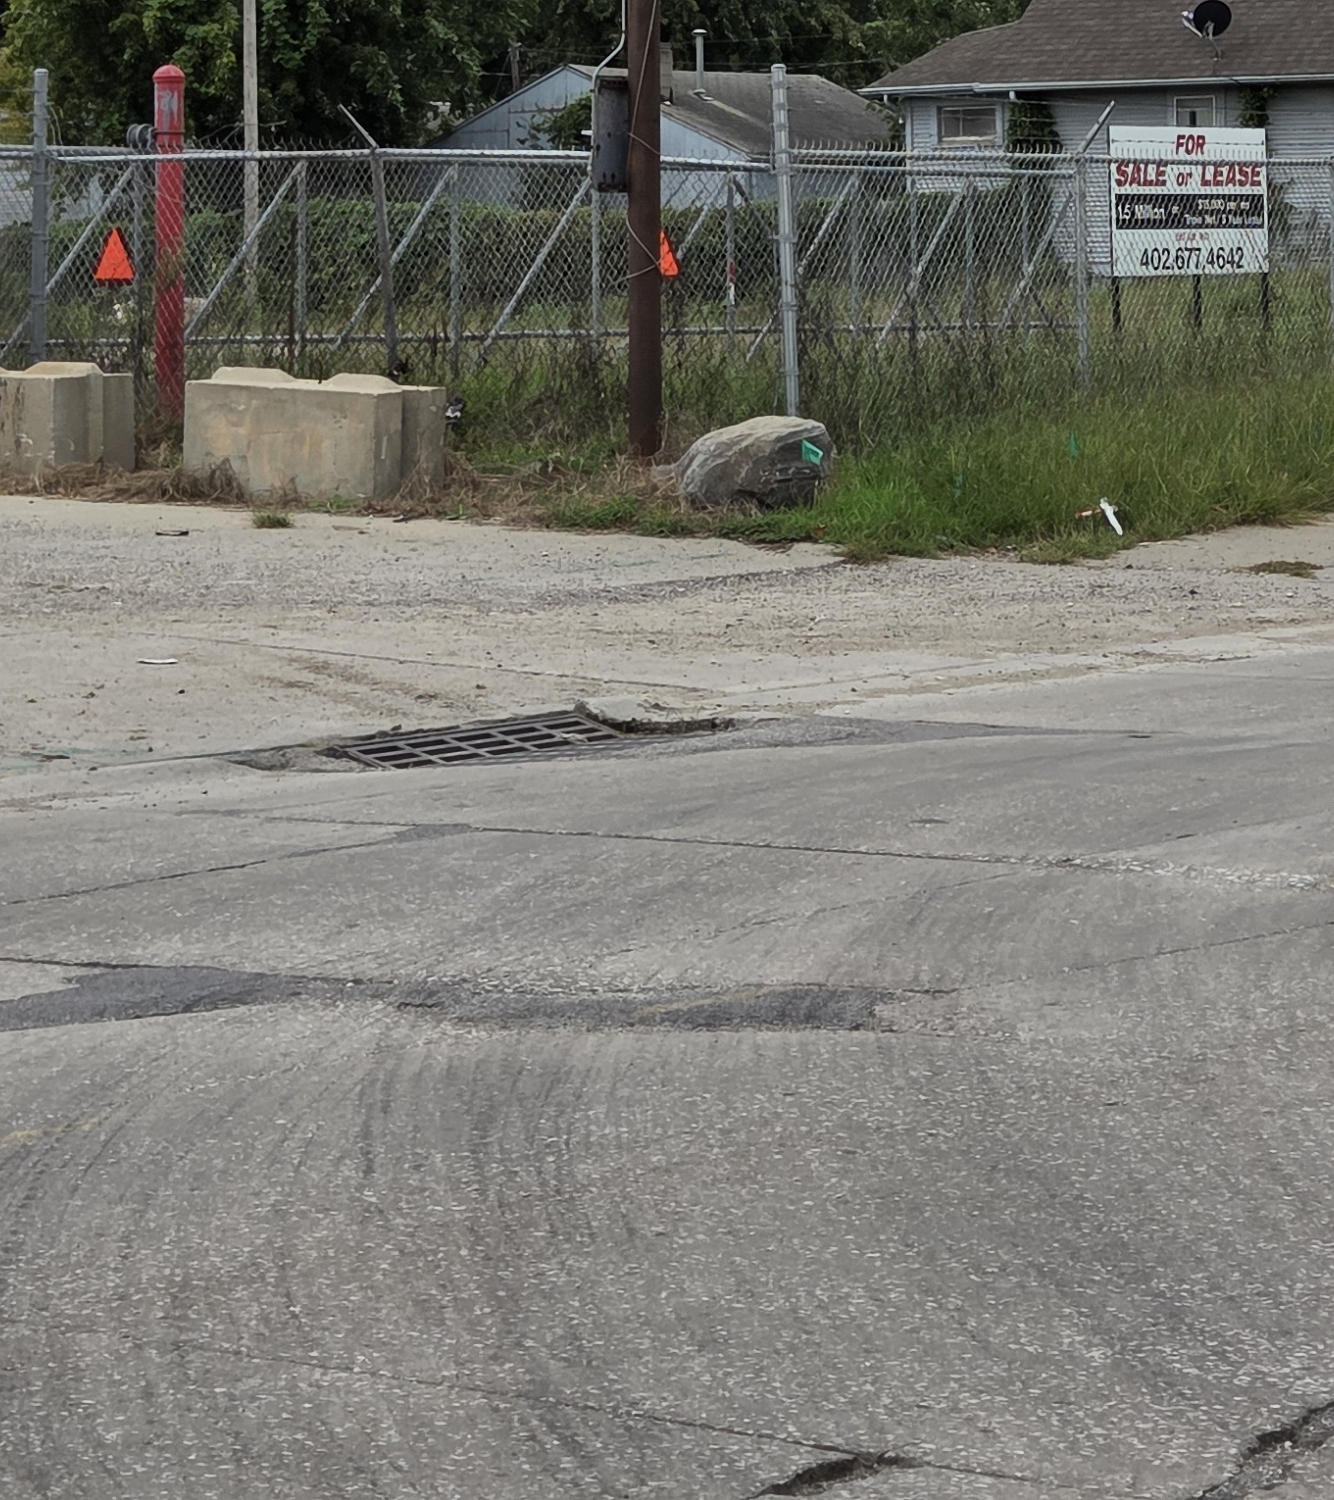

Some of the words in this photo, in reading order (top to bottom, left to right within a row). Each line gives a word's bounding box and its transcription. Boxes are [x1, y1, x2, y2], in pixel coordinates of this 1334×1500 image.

[1175, 134, 1206, 155] FOR
[1115, 160, 1168, 187] SALE
[1176, 171, 1192, 187] or
[1200, 161, 1262, 187] LEASE
